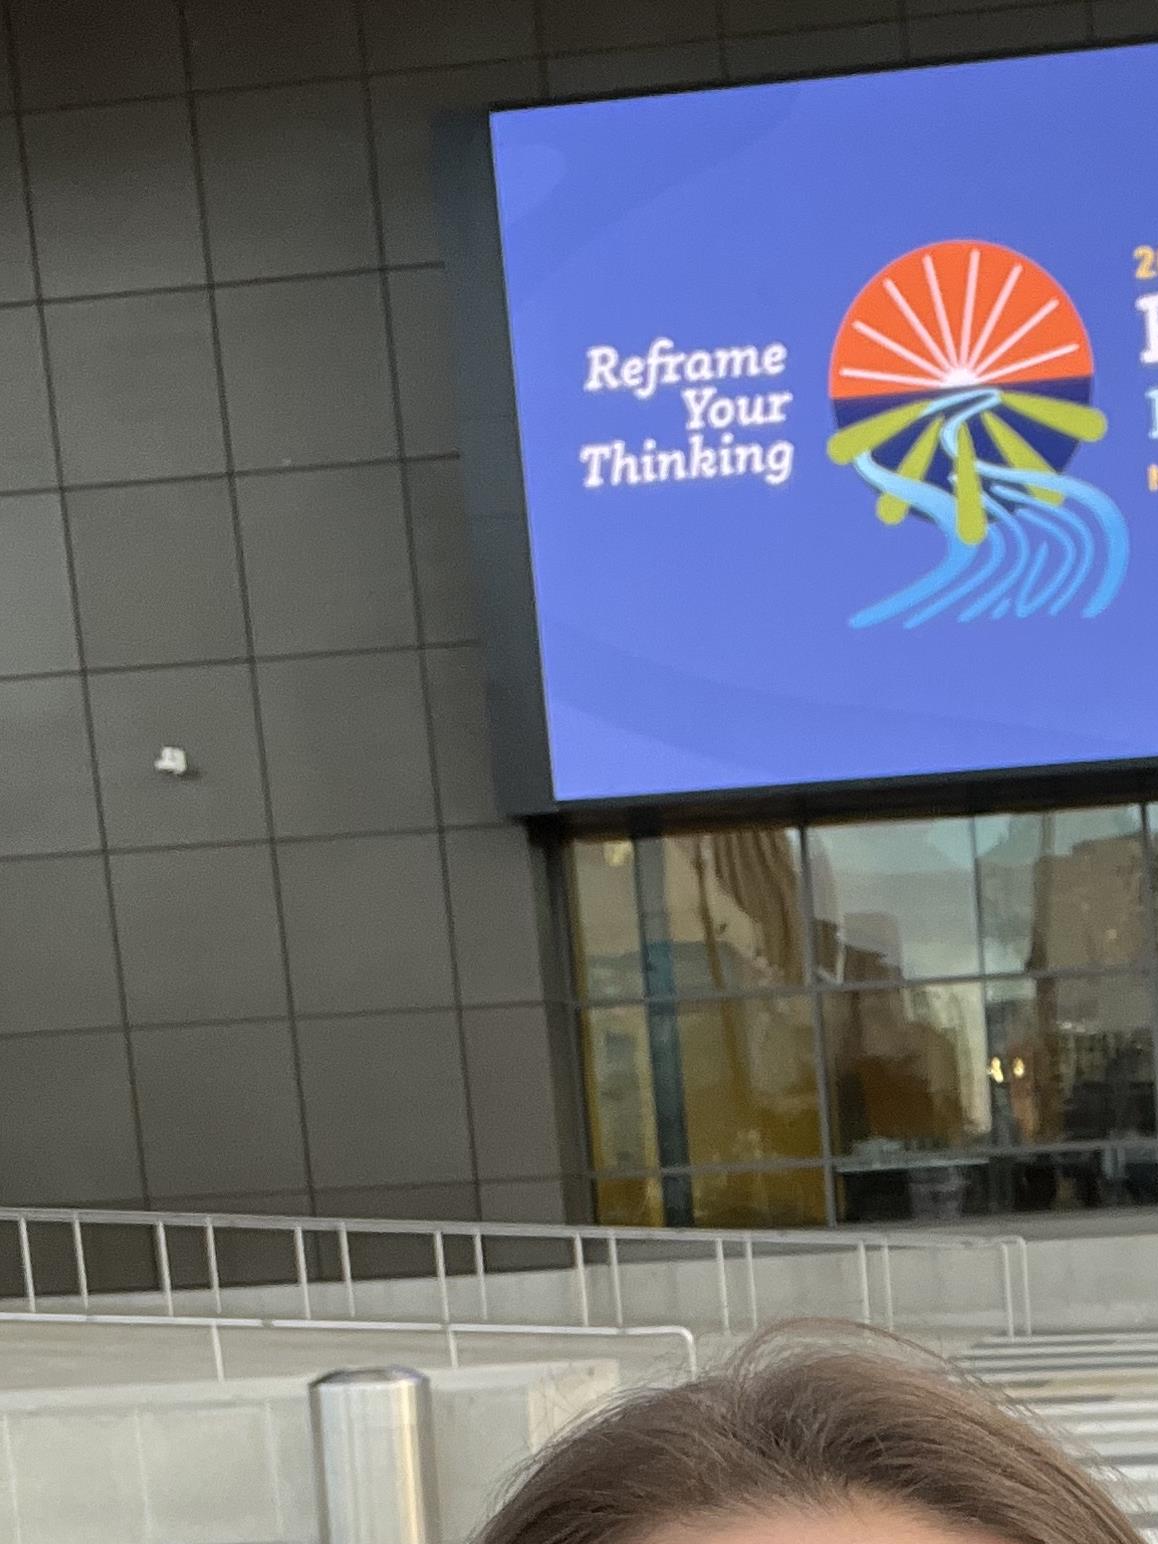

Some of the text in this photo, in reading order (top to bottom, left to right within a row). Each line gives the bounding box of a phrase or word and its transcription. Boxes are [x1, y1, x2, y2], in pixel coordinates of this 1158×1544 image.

[584, 337, 788, 399] Reframe
[683, 387, 793, 430] Your
[580, 432, 794, 488] Thinking
